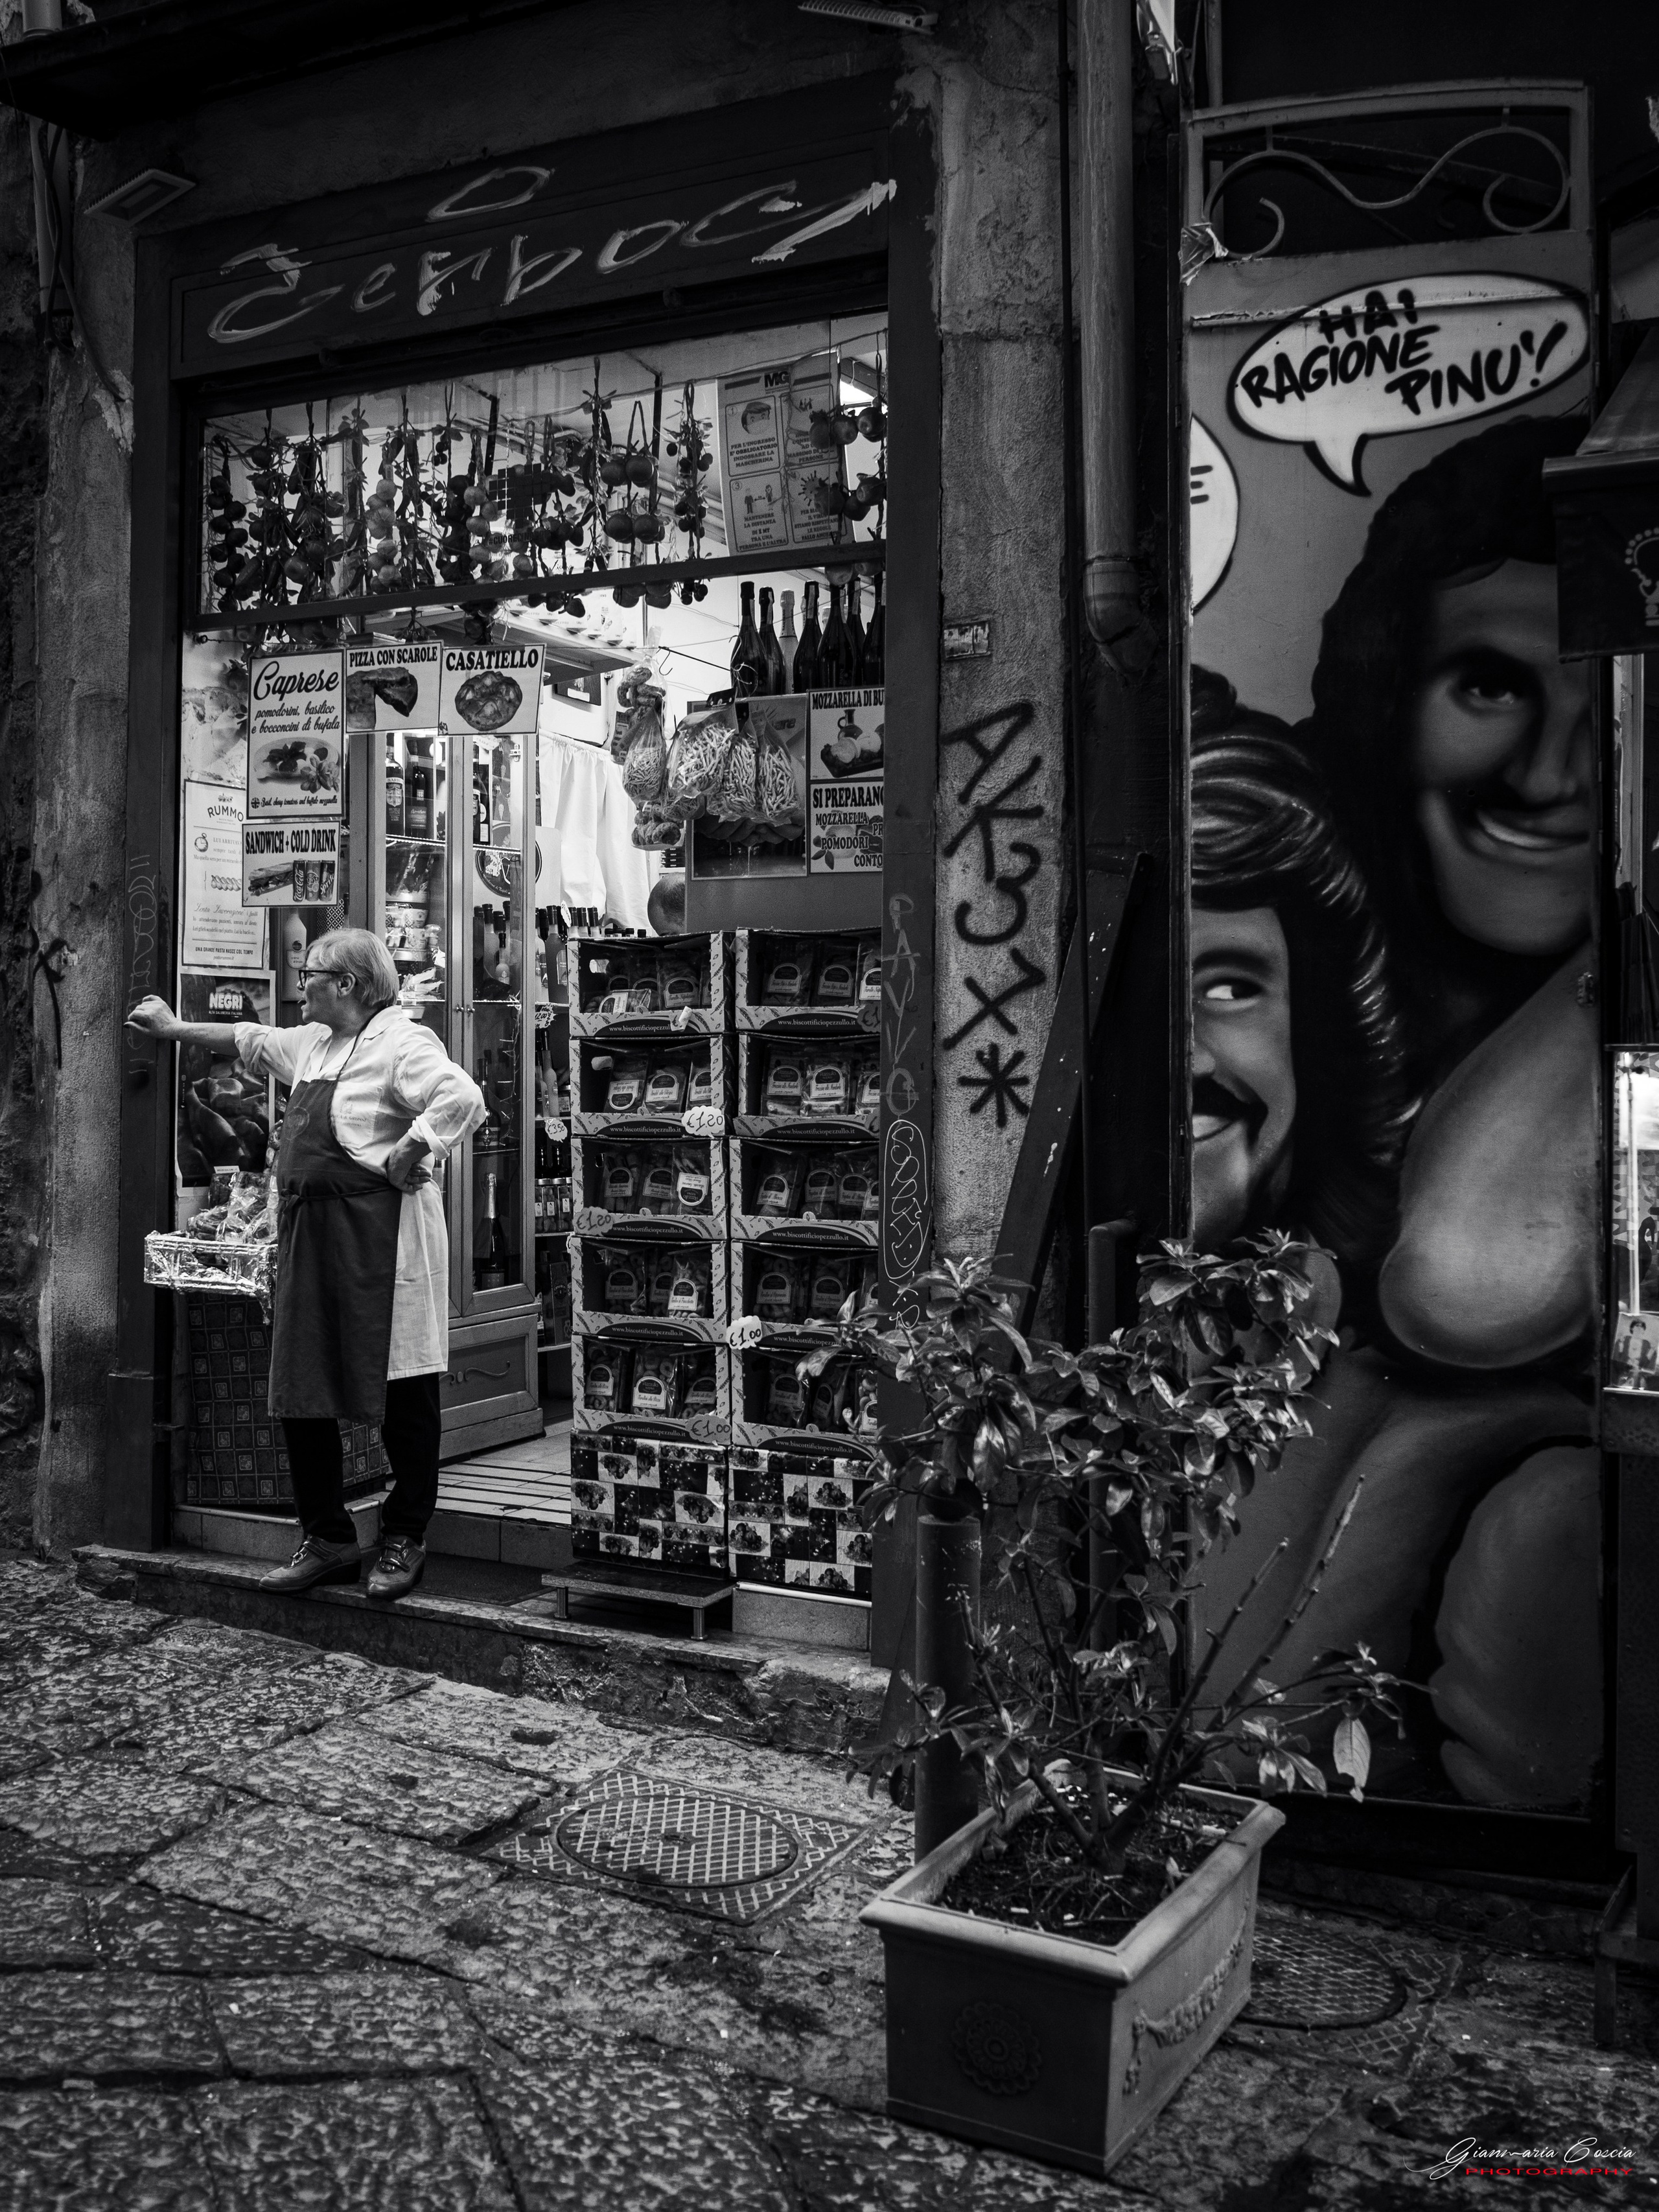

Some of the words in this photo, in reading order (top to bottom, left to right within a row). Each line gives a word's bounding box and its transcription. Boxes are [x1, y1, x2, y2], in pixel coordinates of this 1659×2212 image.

[1318, 288, 1417, 343] HAI
[1240, 324, 1441, 408] RAGIONE
[734, 452, 765, 461] INDOSSARE
[736, 443, 777, 455] OBBLIGATORIO
[736, 457, 773, 467] MASCHERINA
[349, 651, 375, 668] PIZZA
[377, 649, 395, 666] CON
[396, 646, 437, 665] SCAROLE
[446, 649, 539, 671] CASATIELLO
[253, 660, 339, 701] Caprese
[812, 690, 863, 710] MOZZARELLA
[863, 690, 873, 706] DI
[255, 703, 300, 721] pomodorini,
[305, 700, 336, 715] basilico
[259, 719, 300, 733] bocconcini
[302, 717, 311, 731] di
[314, 716, 340, 734] bufala
[813, 789, 825, 809] SI
[207, 805, 244, 822] RUMMO
[815, 811, 868, 826] MOZZARELLA
[246, 830, 284, 855] SANDWICH
[290, 830, 310, 853] COLD
[311, 829, 336, 852] DRINK
[821, 835, 869, 850] POMODORI
[209, 992, 243, 1010] NEGRI
[609, 1024, 671, 1032] www.biscottificiopezzul
[778, 1019, 855, 1027] www.biscottificiopezzullo.it
[610, 1126, 681, 1134] www.biscottificiopezzullo.it
[777, 1128, 855, 1136] www.biscottificiopezzullo.it
[612, 1226, 684, 1235] www.biscottificiopezzullo.it
[772, 1231, 849, 1241] www.biscottificiopezzullo.it
[612, 1327, 684, 1336] www.biscottificiopezzullo.it
[614, 1425, 686, 1437] www.biscottificiopezzullo.it
[776, 1440, 853, 1454] www.biscottificiopezzullo.it
